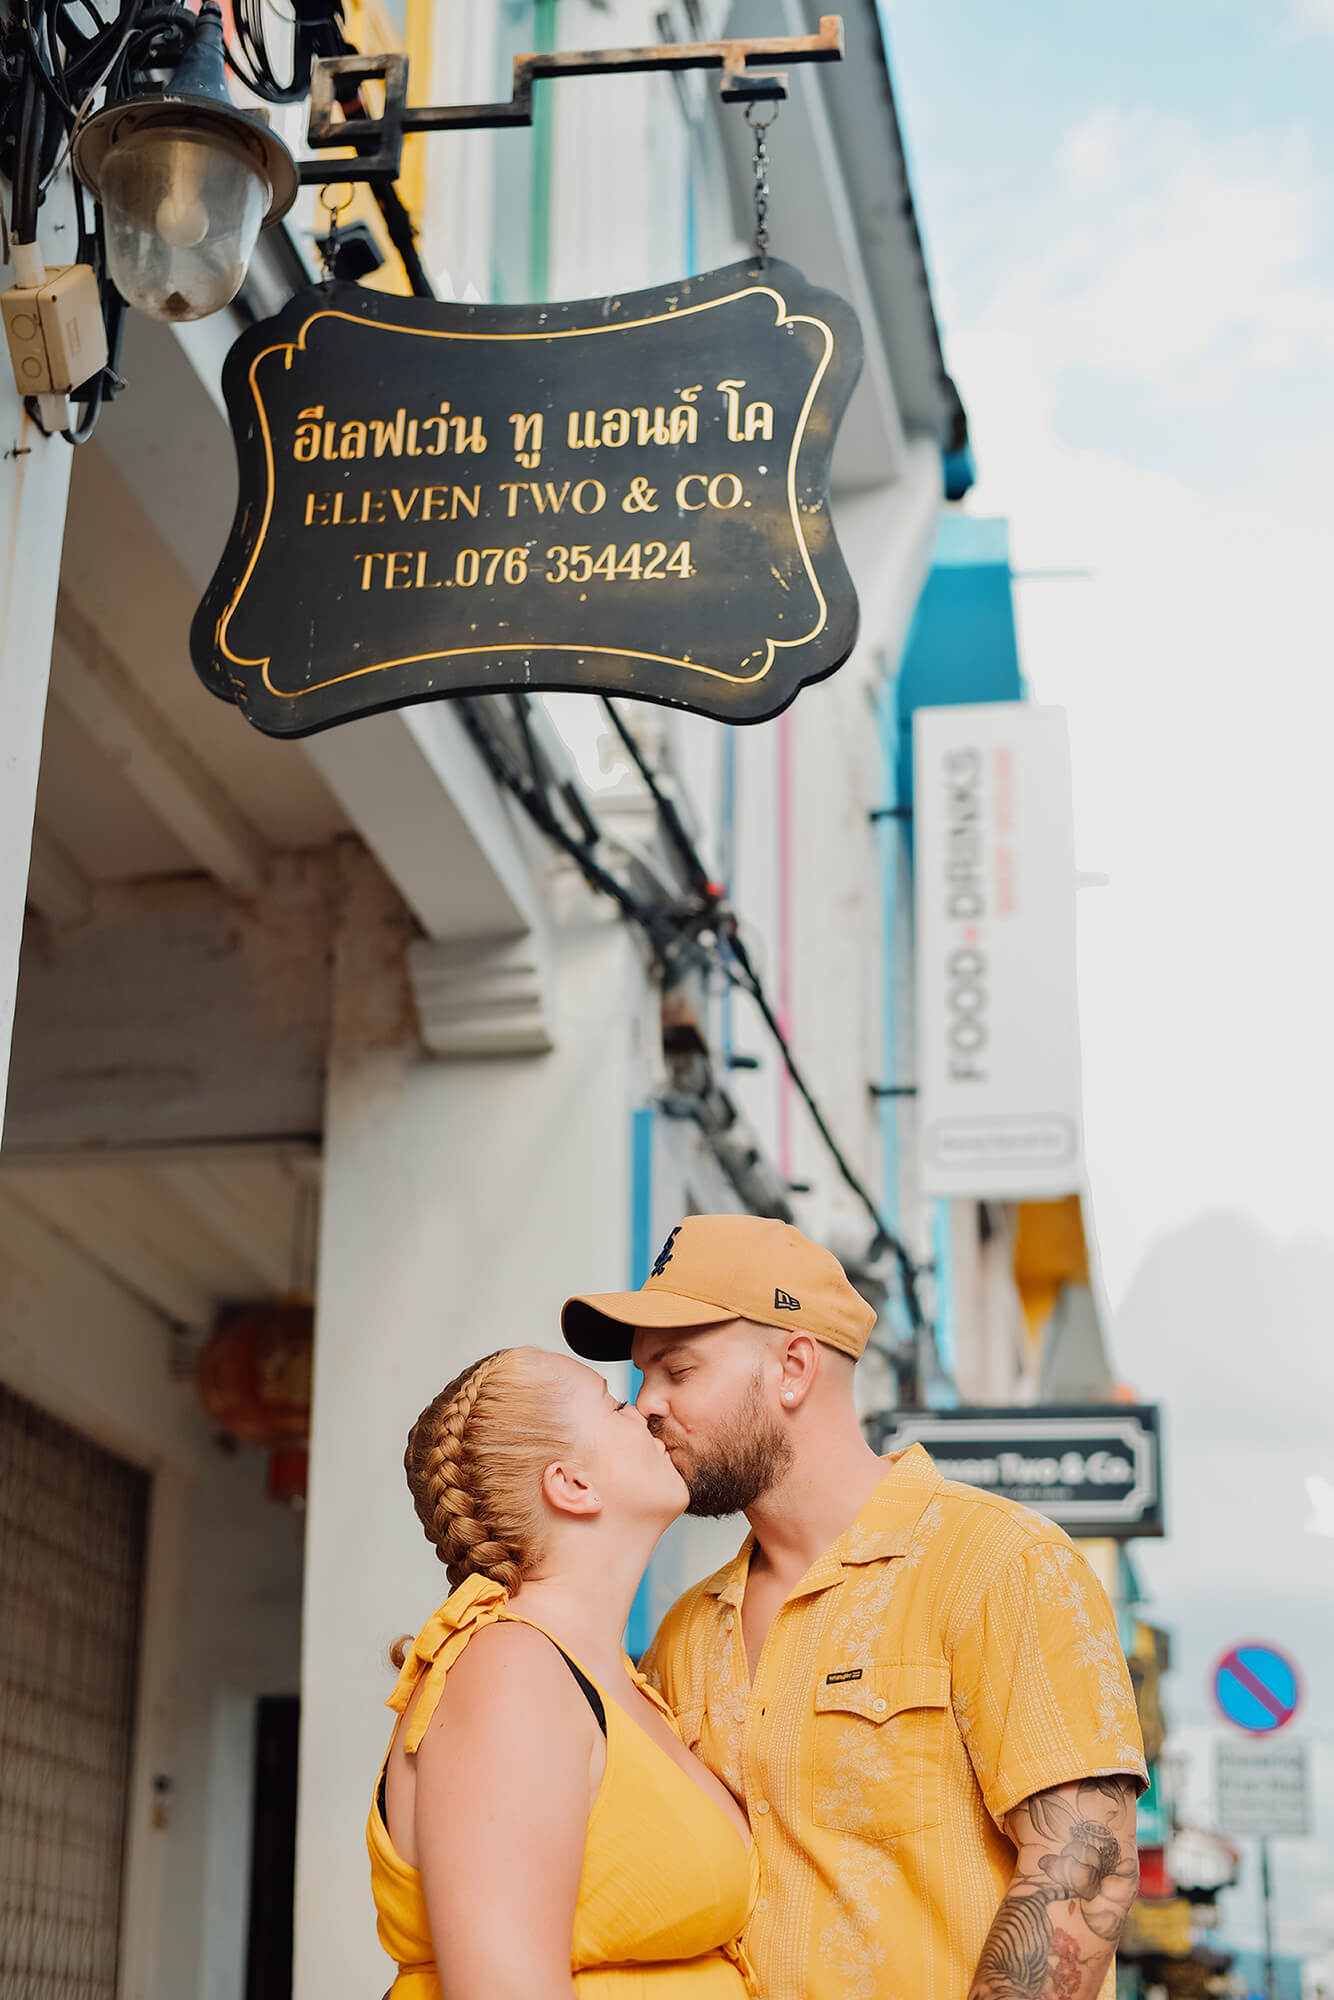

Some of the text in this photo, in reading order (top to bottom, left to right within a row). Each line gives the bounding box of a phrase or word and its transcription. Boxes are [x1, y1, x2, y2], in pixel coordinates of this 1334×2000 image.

[293, 379, 775, 469] อีเลฟเว่น ทู แอนด์ โค
[303, 472, 752, 526] ELEVEN TWO & CO.
[947, 947, 988, 1082] FOOD
